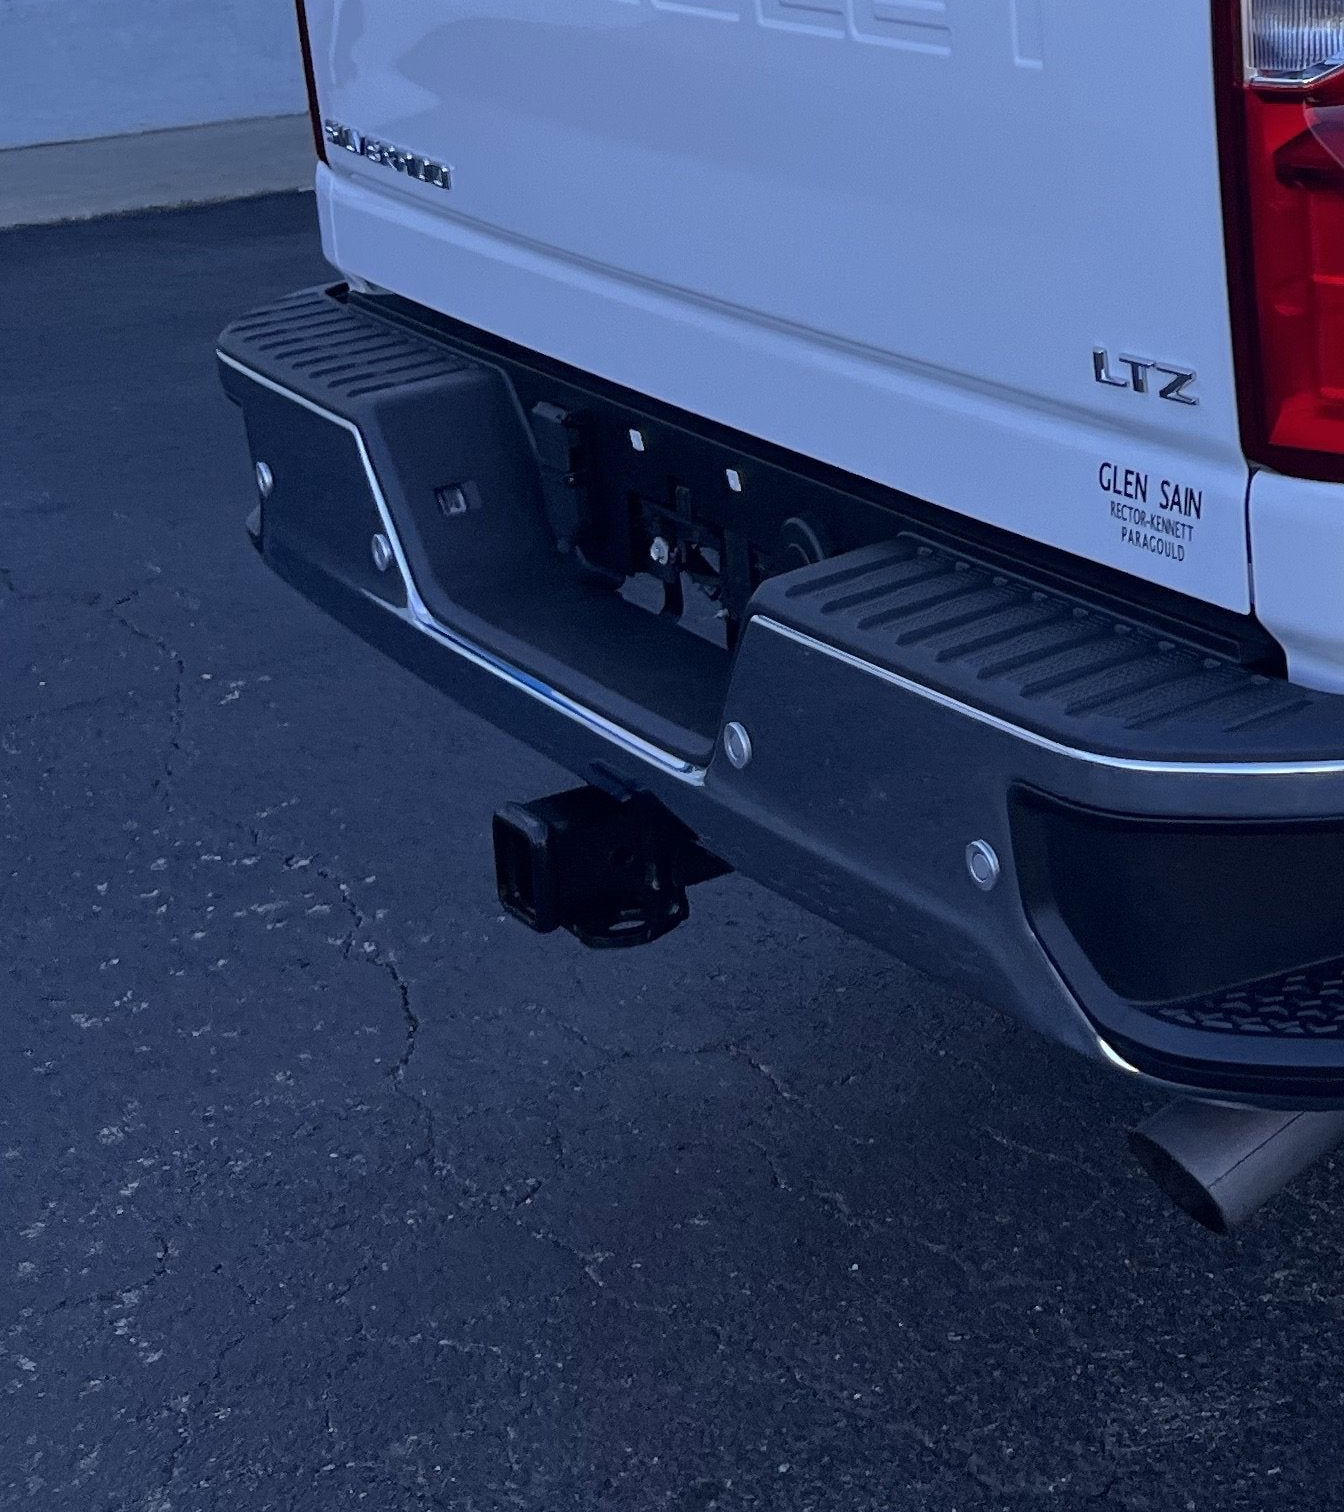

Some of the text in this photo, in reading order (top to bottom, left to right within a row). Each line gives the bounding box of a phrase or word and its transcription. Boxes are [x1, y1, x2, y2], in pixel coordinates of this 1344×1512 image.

[324, 118, 453, 191] SILVERADO
[1092, 346, 1200, 406] LTZ
[1099, 461, 1202, 520] GLEN SAIN
[1110, 500, 1194, 542] RECTOR-KENNETT
[1121, 526, 1185, 562] PARAGOULD
